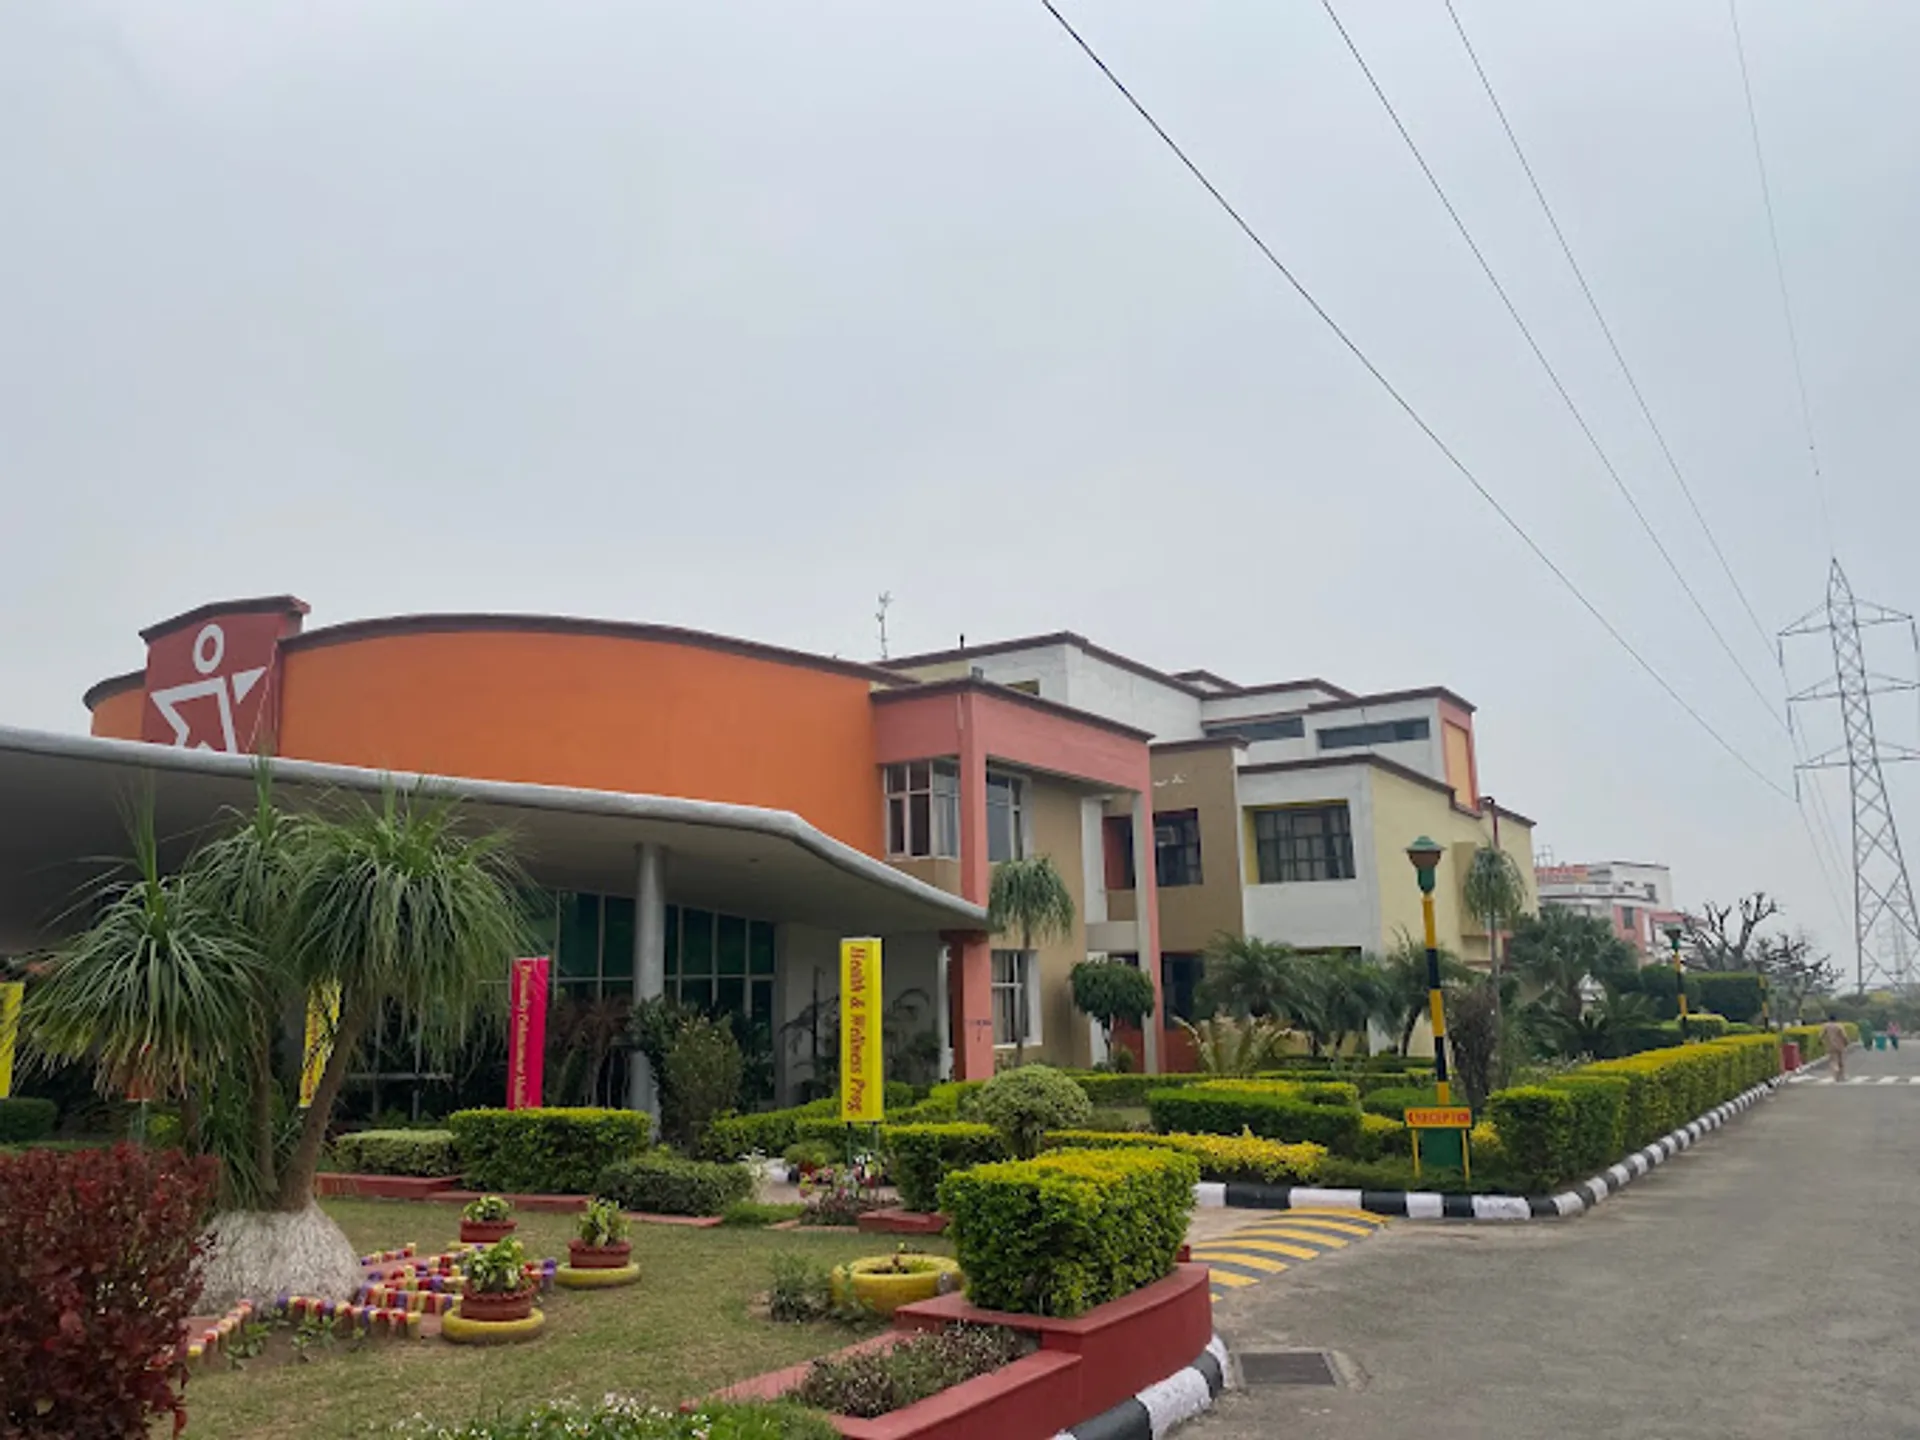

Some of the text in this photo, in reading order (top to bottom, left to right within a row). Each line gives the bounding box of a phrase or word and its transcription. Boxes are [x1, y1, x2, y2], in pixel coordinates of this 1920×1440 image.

[850, 946, 866, 992] Health
[850, 997, 865, 1009] &
[849, 1014, 866, 1073] Wellness
